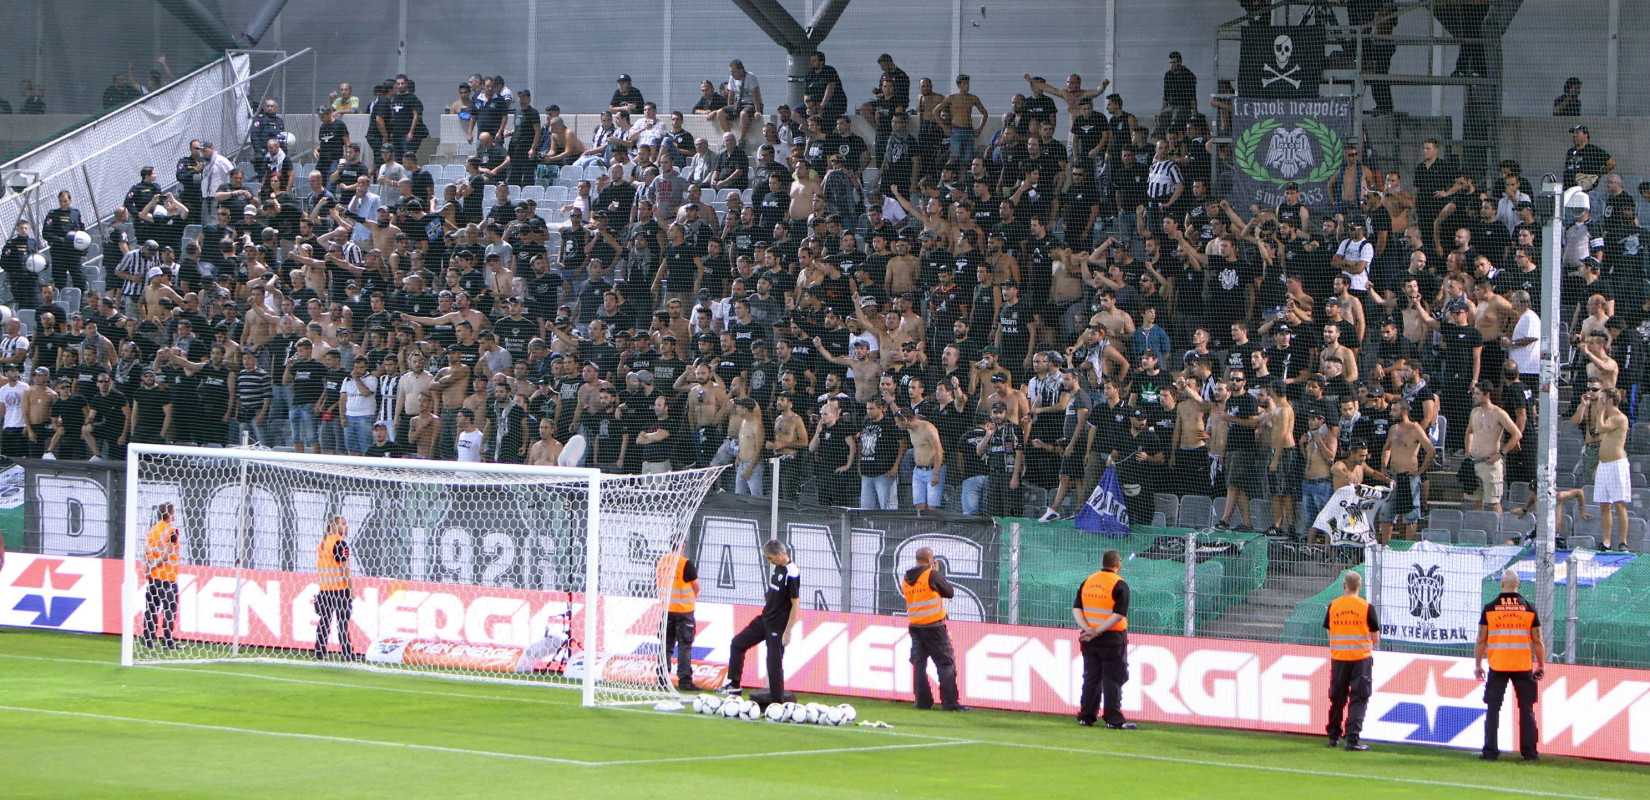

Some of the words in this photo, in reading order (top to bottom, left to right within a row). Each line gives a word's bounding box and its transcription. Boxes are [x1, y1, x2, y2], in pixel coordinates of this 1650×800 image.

[1253, 99, 1285, 119] paok
[1290, 99, 1349, 119] neapolis
[1297, 187, 1323, 206] 963
[409, 524, 557, 591] 1926
[965, 633, 1327, 725] ENRGIE
